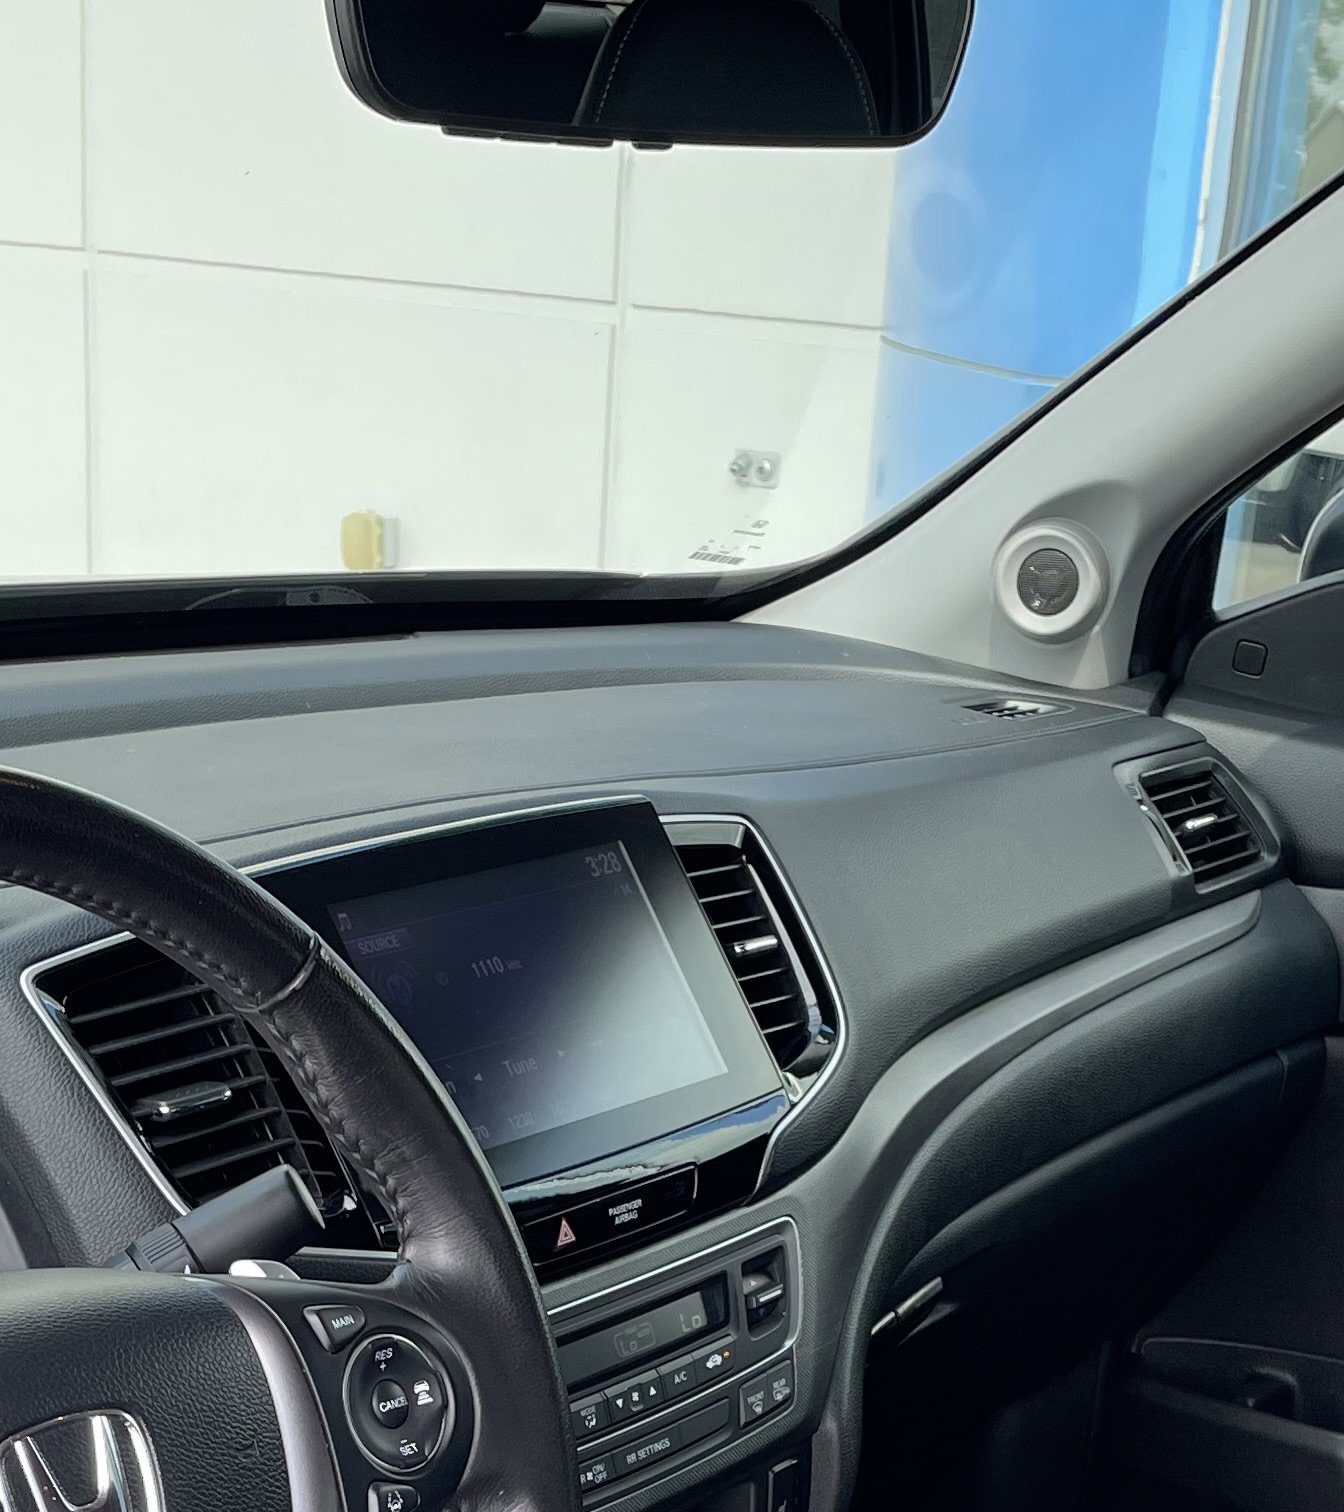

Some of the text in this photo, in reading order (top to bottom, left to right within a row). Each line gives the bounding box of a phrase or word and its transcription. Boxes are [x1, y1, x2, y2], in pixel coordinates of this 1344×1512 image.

[585, 851, 622, 878] 3:28
[357, 933, 400, 955] SOURCE
[471, 956, 504, 979] 1110
[503, 1055, 539, 1077] Tune
[608, 1199, 642, 1216] PASSENGER
[614, 1210, 638, 1225] AIRBAG
[331, 1314, 355, 1330] MAIN
[374, 1347, 393, 1362] RES
[673, 1370, 688, 1385] A/C
[399, 1442, 419, 1457] SET
[626, 1437, 671, 1465] RR SETTINGS
[594, 1473, 608, 1485] OFF
